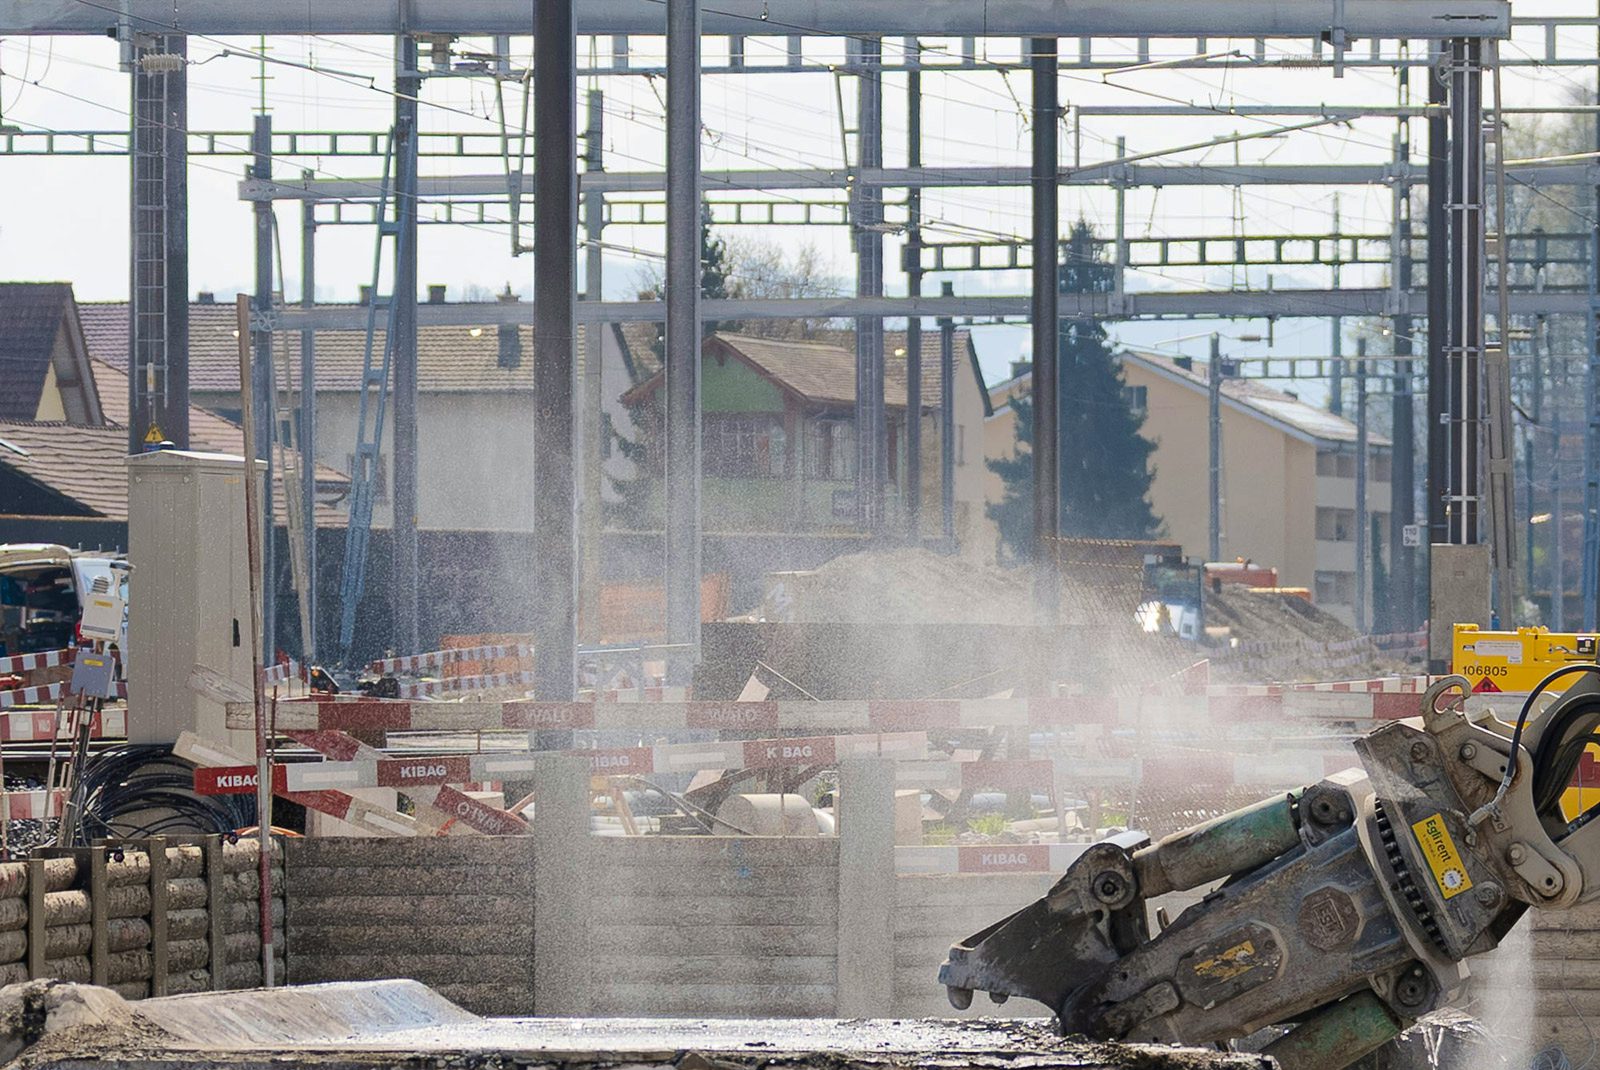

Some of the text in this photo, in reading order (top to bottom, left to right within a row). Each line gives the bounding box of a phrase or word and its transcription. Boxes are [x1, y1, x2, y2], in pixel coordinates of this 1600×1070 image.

[1462, 665, 1508, 677] 106805
[401, 765, 447, 778] KIBAG
[982, 852, 1028, 866] KIBAG
